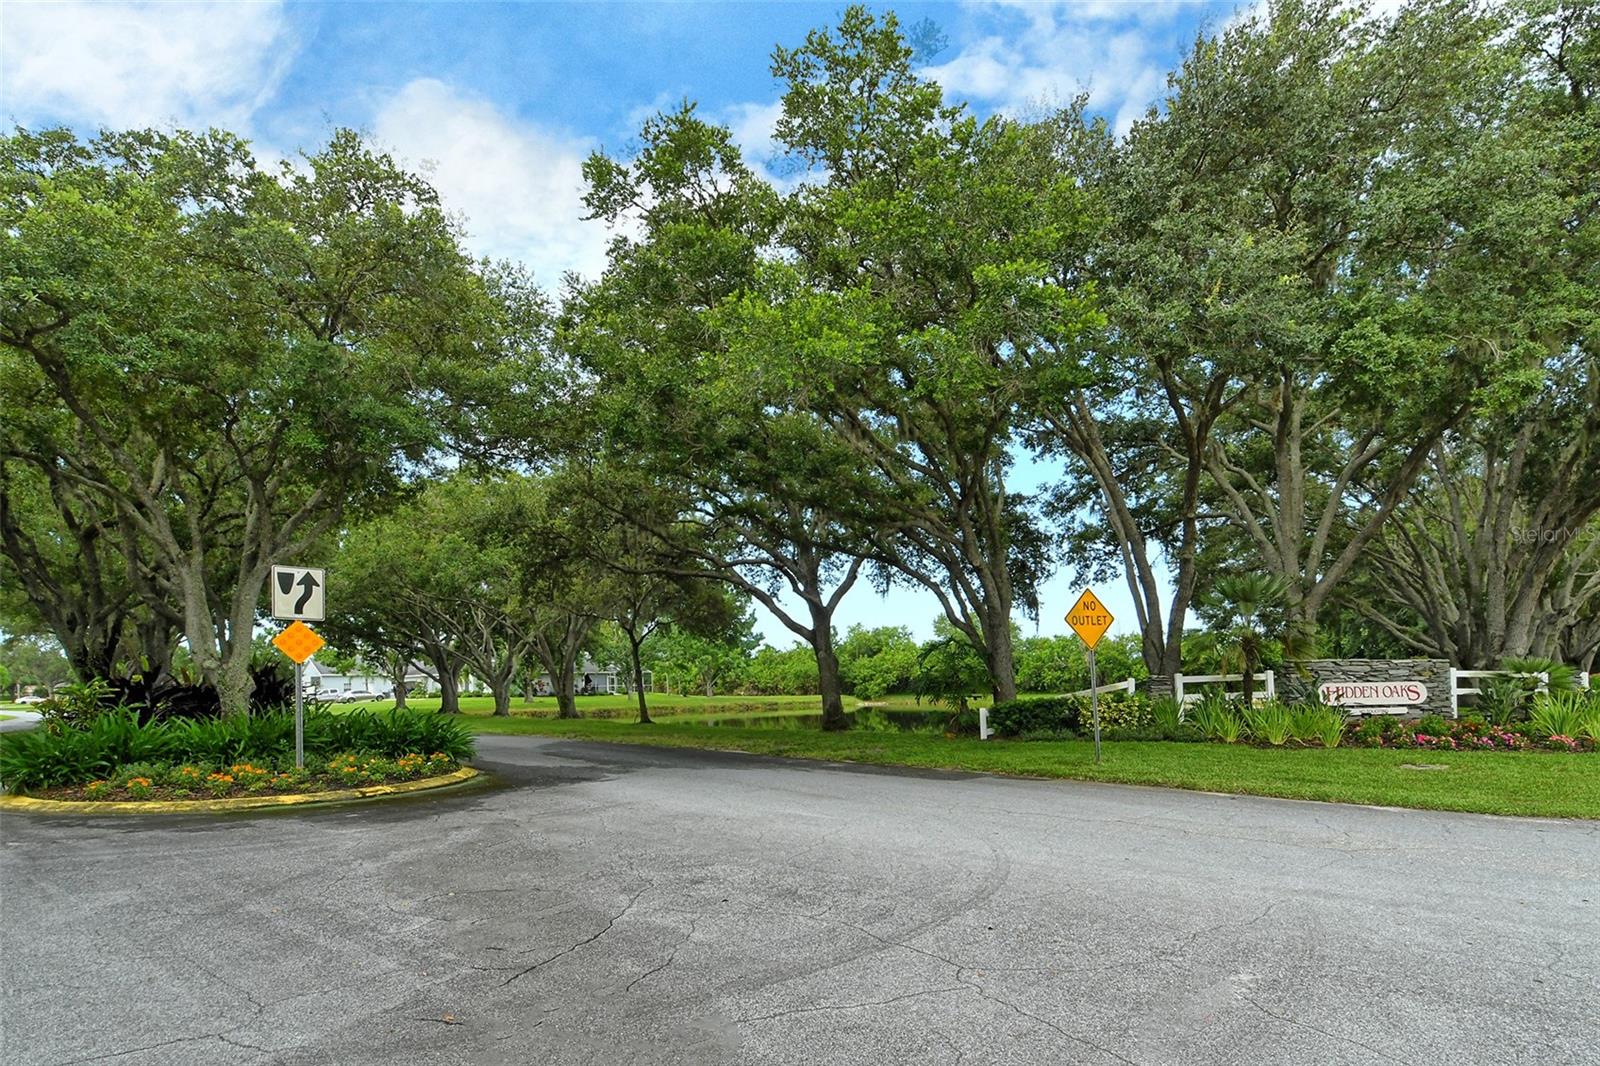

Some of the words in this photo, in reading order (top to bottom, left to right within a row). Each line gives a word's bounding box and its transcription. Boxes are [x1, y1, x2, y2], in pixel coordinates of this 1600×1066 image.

[1083, 601, 1096, 611] NO
[1072, 616, 1107, 626] OUTLET
[1326, 686, 1379, 702] HIDDEN
[1383, 685, 1420, 701] OAKS
